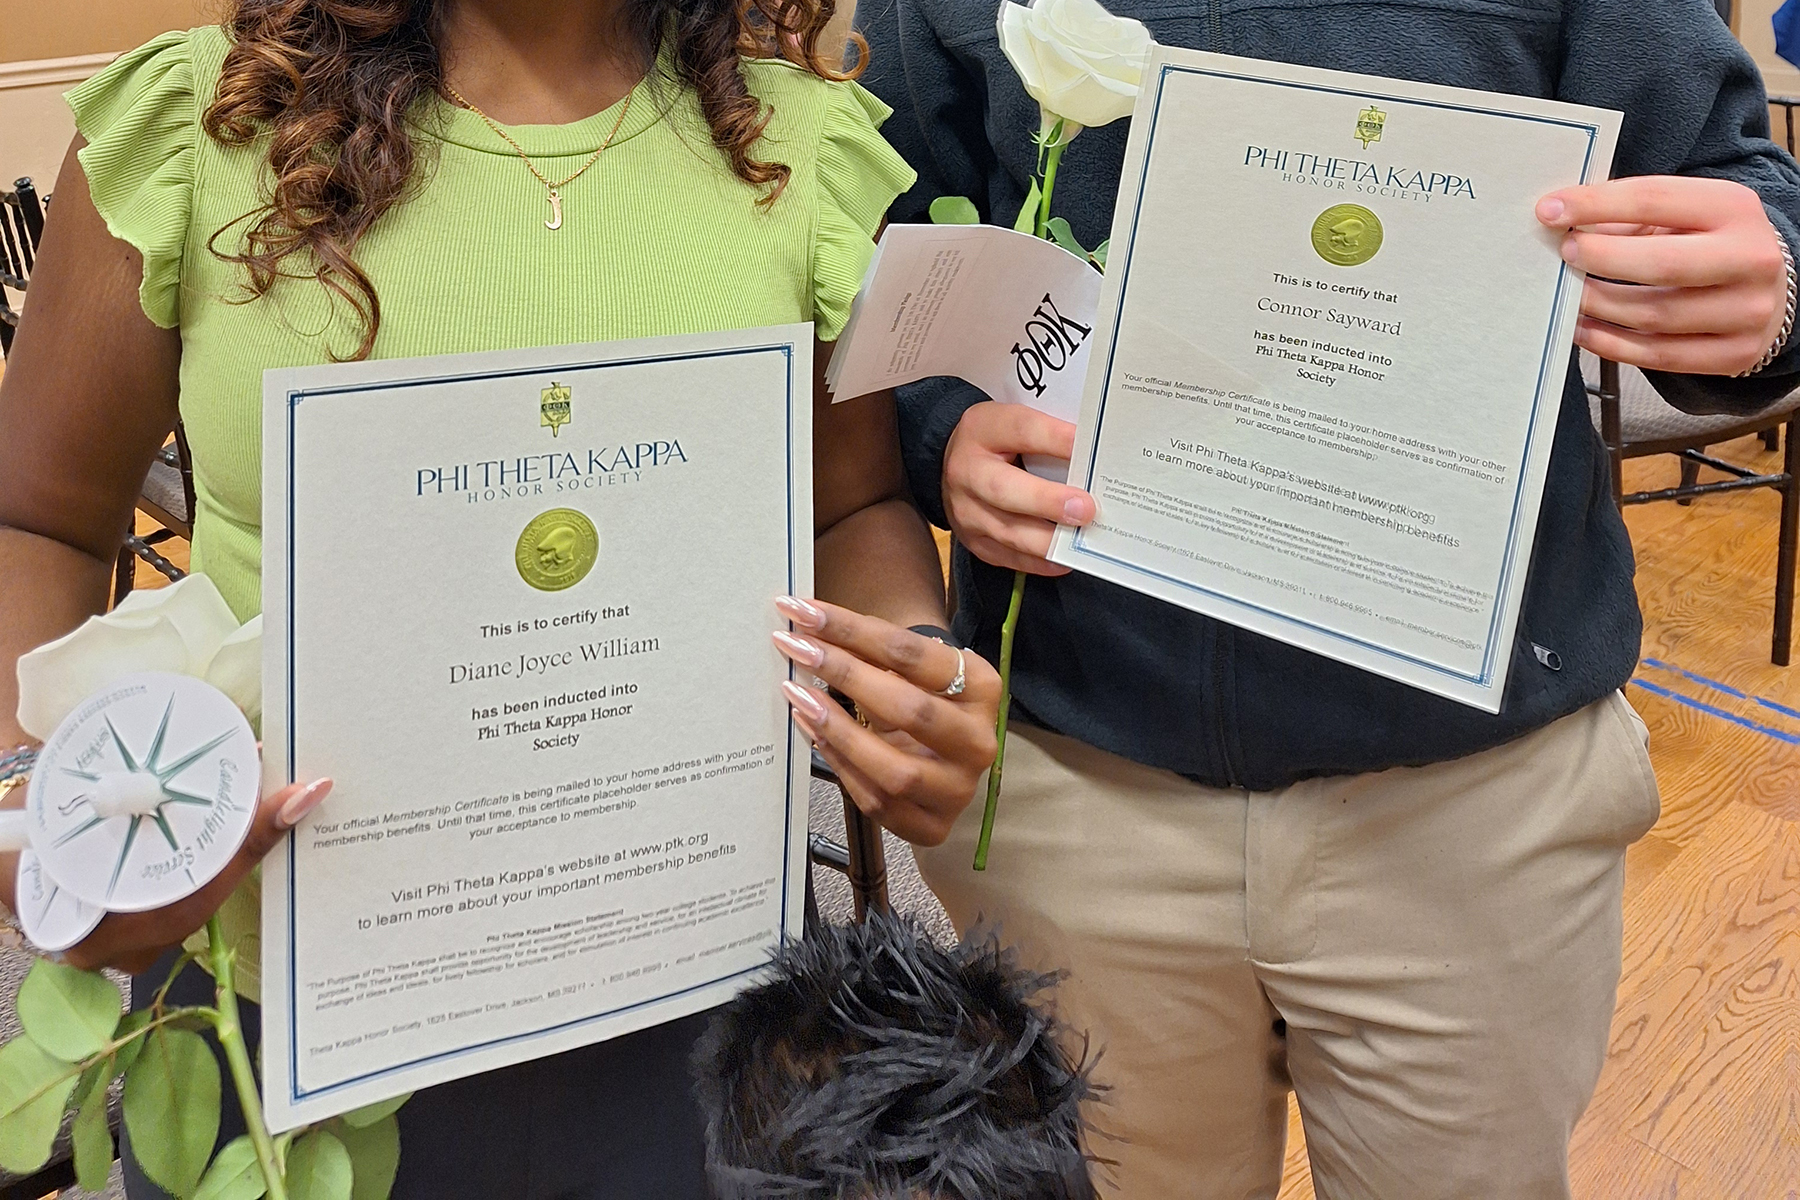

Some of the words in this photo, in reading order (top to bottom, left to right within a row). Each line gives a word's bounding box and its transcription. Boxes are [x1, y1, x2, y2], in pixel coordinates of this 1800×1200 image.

[1244, 146, 1289, 171] PHI
[1295, 152, 1380, 185] THETA
[1386, 166, 1476, 200] KAPPA
[1282, 172, 1345, 190] HONOR
[1356, 183, 1433, 203] SOCIETY
[1273, 273, 1298, 286] This
[1302, 277, 1312, 288] is
[1316, 280, 1328, 290] to
[1331, 284, 1371, 300] certify
[1373, 290, 1398, 304] that
[1257, 297, 1323, 319] Connor
[1326, 308, 1402, 336] Sayward
[1253, 329, 1276, 342] has
[1278, 333, 1308, 347] been
[1311, 339, 1366, 360] inducted
[1368, 351, 1393, 367] into
[1255, 345, 1274, 356] Phi
[1276, 348, 1307, 363] Theta
[1309, 354, 1345, 372] Kappa
[1347, 363, 1386, 381] Honor
[1296, 368, 1337, 387] Society
[1121, 383, 1174, 398] membership
[1213, 399, 1233, 409] Until
[1234, 403, 1251, 414] that
[1275, 413, 1292, 425] this
[1293, 419, 1336, 437] certificate
[1336, 431, 1390, 452] placeholder
[1390, 446, 1421, 461] serves
[1422, 455, 1434, 465] as
[1435, 459, 1493, 481] confirmation
[1494, 476, 1505, 485] of
[1124, 372, 1143, 382] Your
[1144, 377, 1172, 387] official
[1173, 381, 1227, 398] Membership
[1228, 391, 1272, 407] Certificate
[1272, 402, 1281, 410] is
[1282, 403, 1307, 419] being
[1308, 411, 1338, 425] mailed
[1339, 419, 1349, 428] to
[1350, 422, 1371, 434] your
[1371, 428, 1398, 442] home
[1398, 437, 1436, 453] address
[1437, 447, 1457, 459] with
[1458, 453, 1480, 465] your
[1481, 460, 1507, 472] other
[1235, 416, 1256, 426] your
[1256, 421, 1306, 441] acceptance
[1307, 434, 1317, 444] to
[417, 464, 468, 496] PHI
[476, 452, 582, 488] THETA
[588, 439, 688, 475] KAPPA
[1142, 447, 1153, 458] to
[1155, 450, 1183, 466] learn
[1185, 460, 1214, 475] more
[1215, 468, 1248, 485] about
[1170, 438, 1194, 453] Visit
[1195, 444, 1214, 458] Phi
[1217, 449, 1248, 468] Theta
[1250, 460, 1295, 482] Kappa's
[468, 484, 543, 504] HONOR
[556, 470, 643, 492] SOCIETY
[480, 623, 512, 638] This
[517, 620, 530, 633] is
[534, 619, 549, 630] to
[552, 609, 598, 627] certify
[602, 605, 630, 620] that
[450, 661, 512, 684] Diane
[516, 651, 572, 678] Joyce
[579, 637, 660, 662] William
[472, 707, 499, 721] has
[503, 700, 539, 715] been
[544, 686, 607, 708] inducted
[611, 683, 638, 697] into
[478, 724, 500, 740] Phi
[503, 720, 542, 736] Theta
[545, 712, 587, 729] Kappa
[591, 704, 633, 721] Honor
[533, 733, 580, 751] Society
[195, 757, 239, 852] Candlelight
[313, 824, 340, 834] Your
[342, 815, 380, 830] official
[382, 805, 452, 824] Membership
[454, 795, 510, 812] Certificate
[512, 792, 521, 802] is
[523, 787, 554, 800] being
[555, 778, 591, 794] mailed
[593, 777, 604, 787] to
[606, 772, 628, 787] your
[631, 767, 660, 780] home
[662, 758, 702, 774] address
[704, 753, 724, 765] with
[726, 749, 748, 763] your
[750, 744, 774, 756] other
[313, 831, 385, 849] membership
[437, 816, 463, 830] Until
[465, 812, 486, 824] that
[518, 804, 537, 816] this
[540, 794, 591, 811] certificate
[592, 782, 652, 803] placeholder
[654, 775, 688, 789] serves
[690, 772, 702, 782] as
[704, 760, 763, 779] confirmation
[765, 755, 775, 766] of
[469, 826, 494, 841] your
[496, 815, 558, 834] acceptance
[560, 812, 571, 822] to
[141, 846, 196, 881] Service
[391, 887, 422, 903] Visit
[426, 883, 450, 897] Phi
[454, 876, 495, 892] Theta
[499, 864, 555, 885] Kappa's
[558, 854, 610, 873] website
[614, 849, 627, 862] at
[358, 918, 372, 930] to
[376, 911, 413, 927] learn
[417, 904, 454, 919] more
[458, 893, 498, 912] about
[502, 889, 533, 908] your
[537, 874, 600, 898] important
[603, 856, 685, 884] membership
[688, 844, 737, 865] benefits
